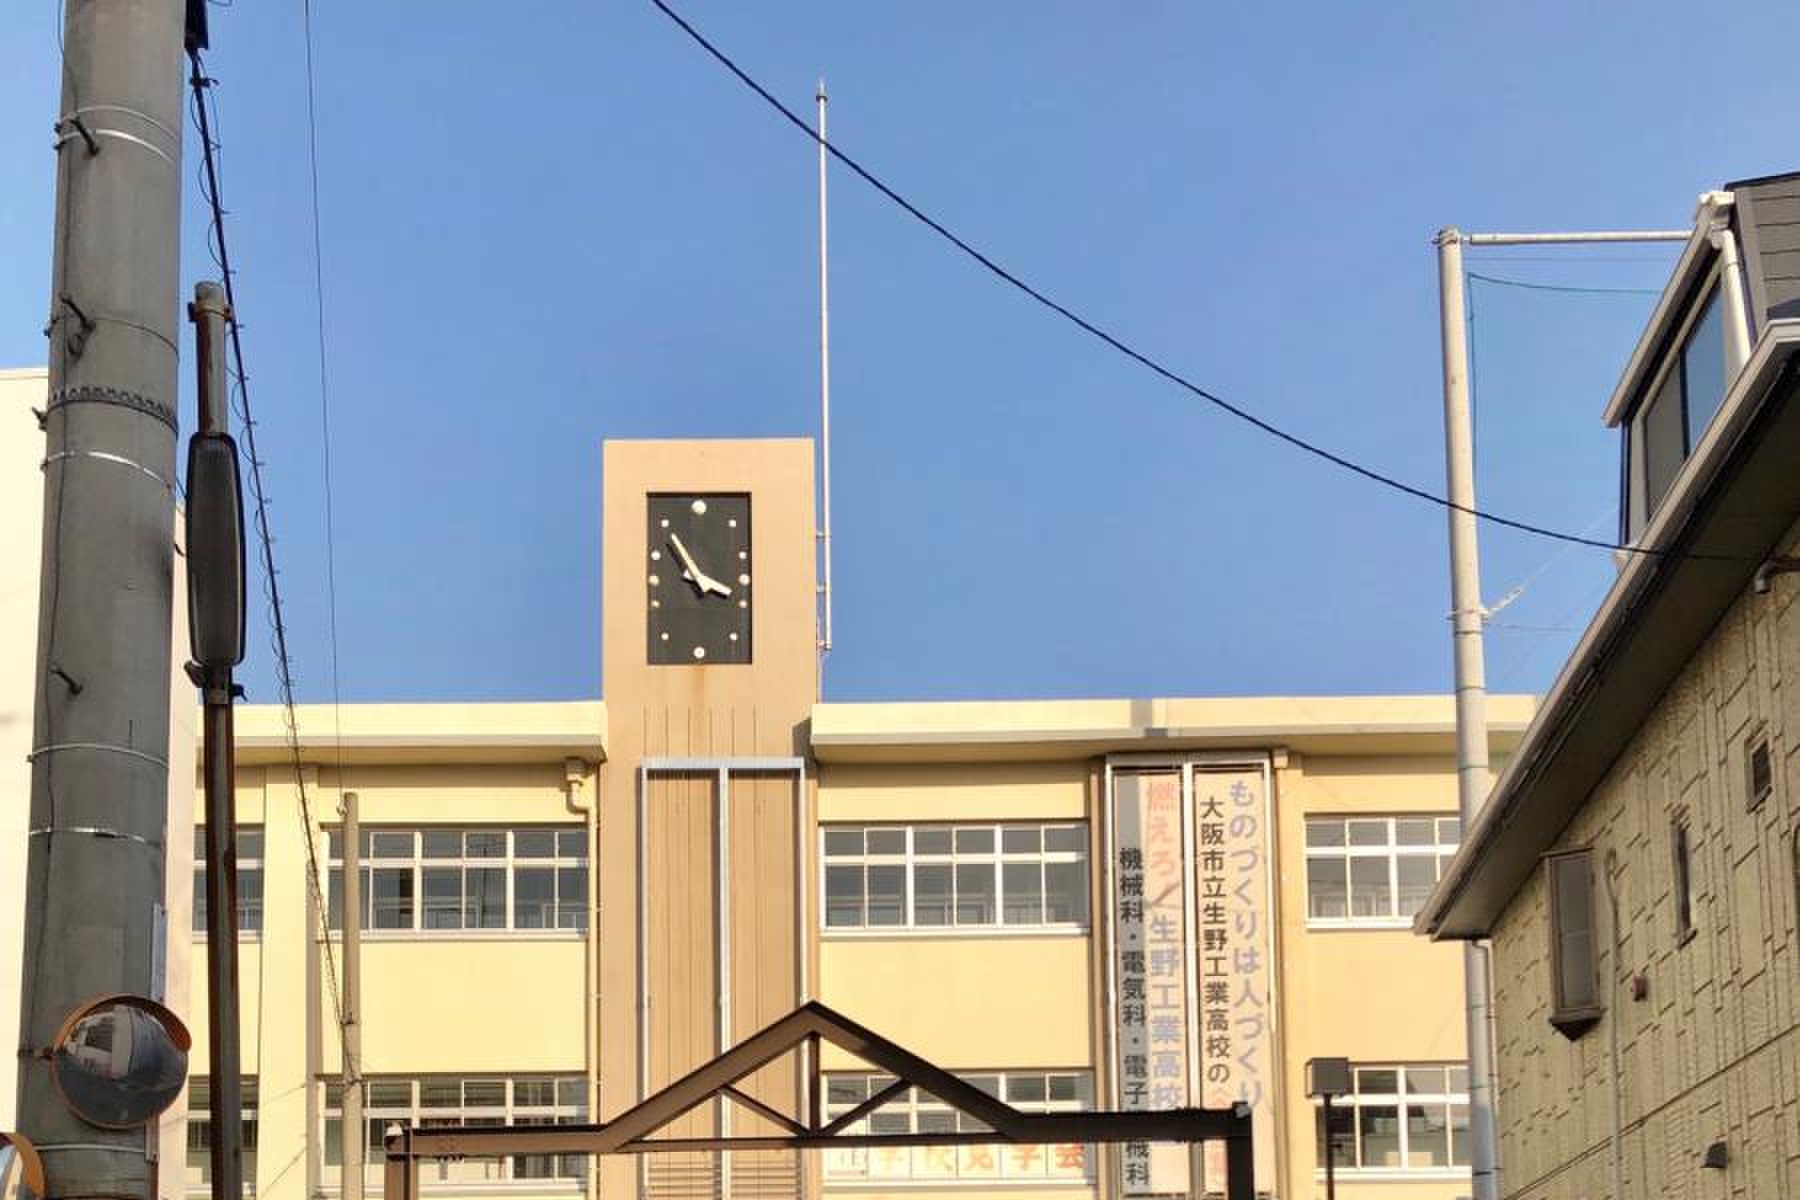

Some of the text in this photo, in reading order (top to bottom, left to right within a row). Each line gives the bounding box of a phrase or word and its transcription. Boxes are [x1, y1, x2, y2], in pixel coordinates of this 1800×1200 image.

[1119, 847, 1151, 1186] 機械科・電気科・電子械科
[1229, 779, 1265, 1110] ものづくりは人づくり
